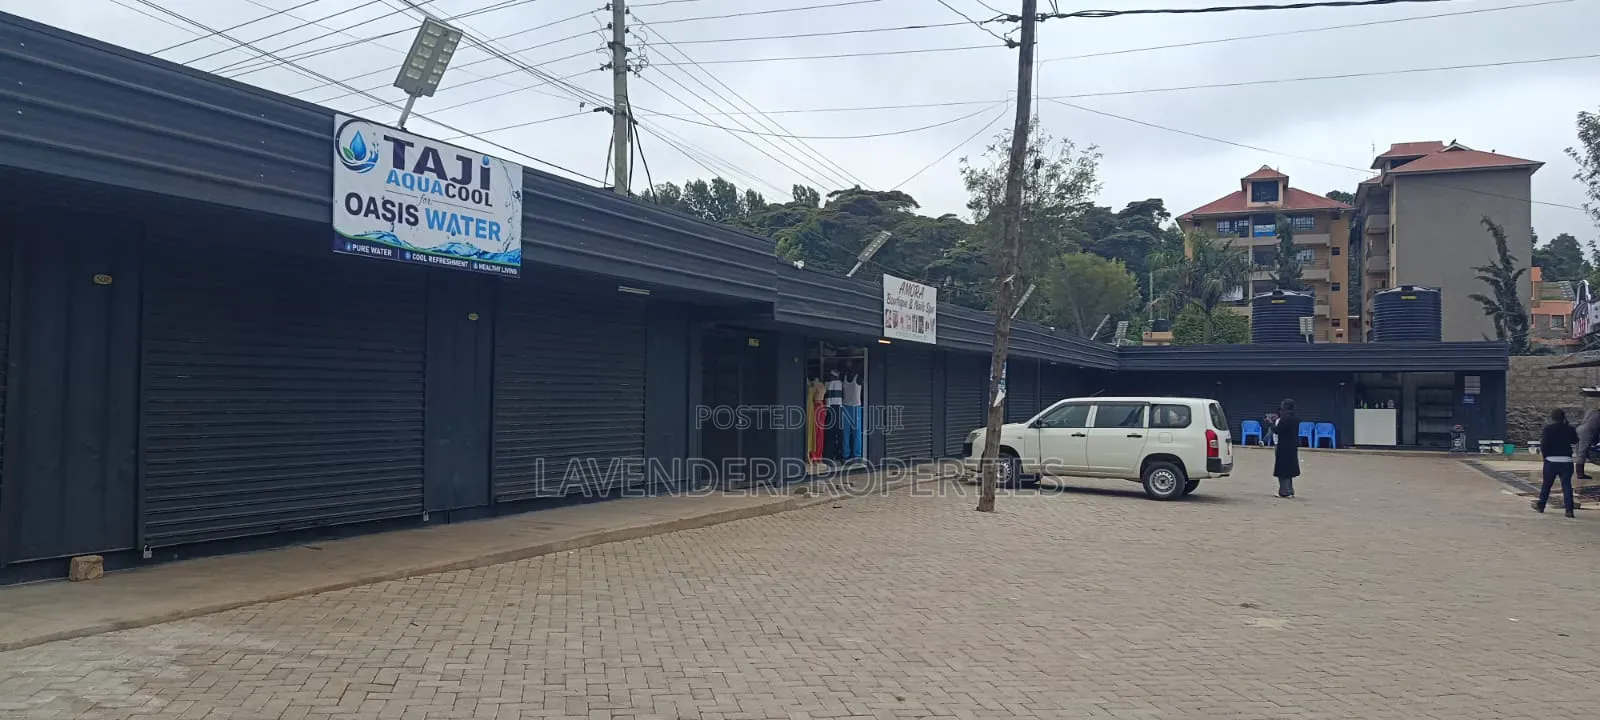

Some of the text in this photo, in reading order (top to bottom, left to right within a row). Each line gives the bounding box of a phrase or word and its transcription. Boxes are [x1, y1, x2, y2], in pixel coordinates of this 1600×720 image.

[385, 169, 493, 207] AQUACOOL
[417, 193, 432, 206] for
[344, 191, 502, 242] OASIS WATER
[352, 243, 393, 257] PURE WATER
[412, 253, 469, 268] COOL REFRESHMENT
[478, 262, 518, 275] HEALTHY LIVING
[899, 281, 924, 299] AMORA
